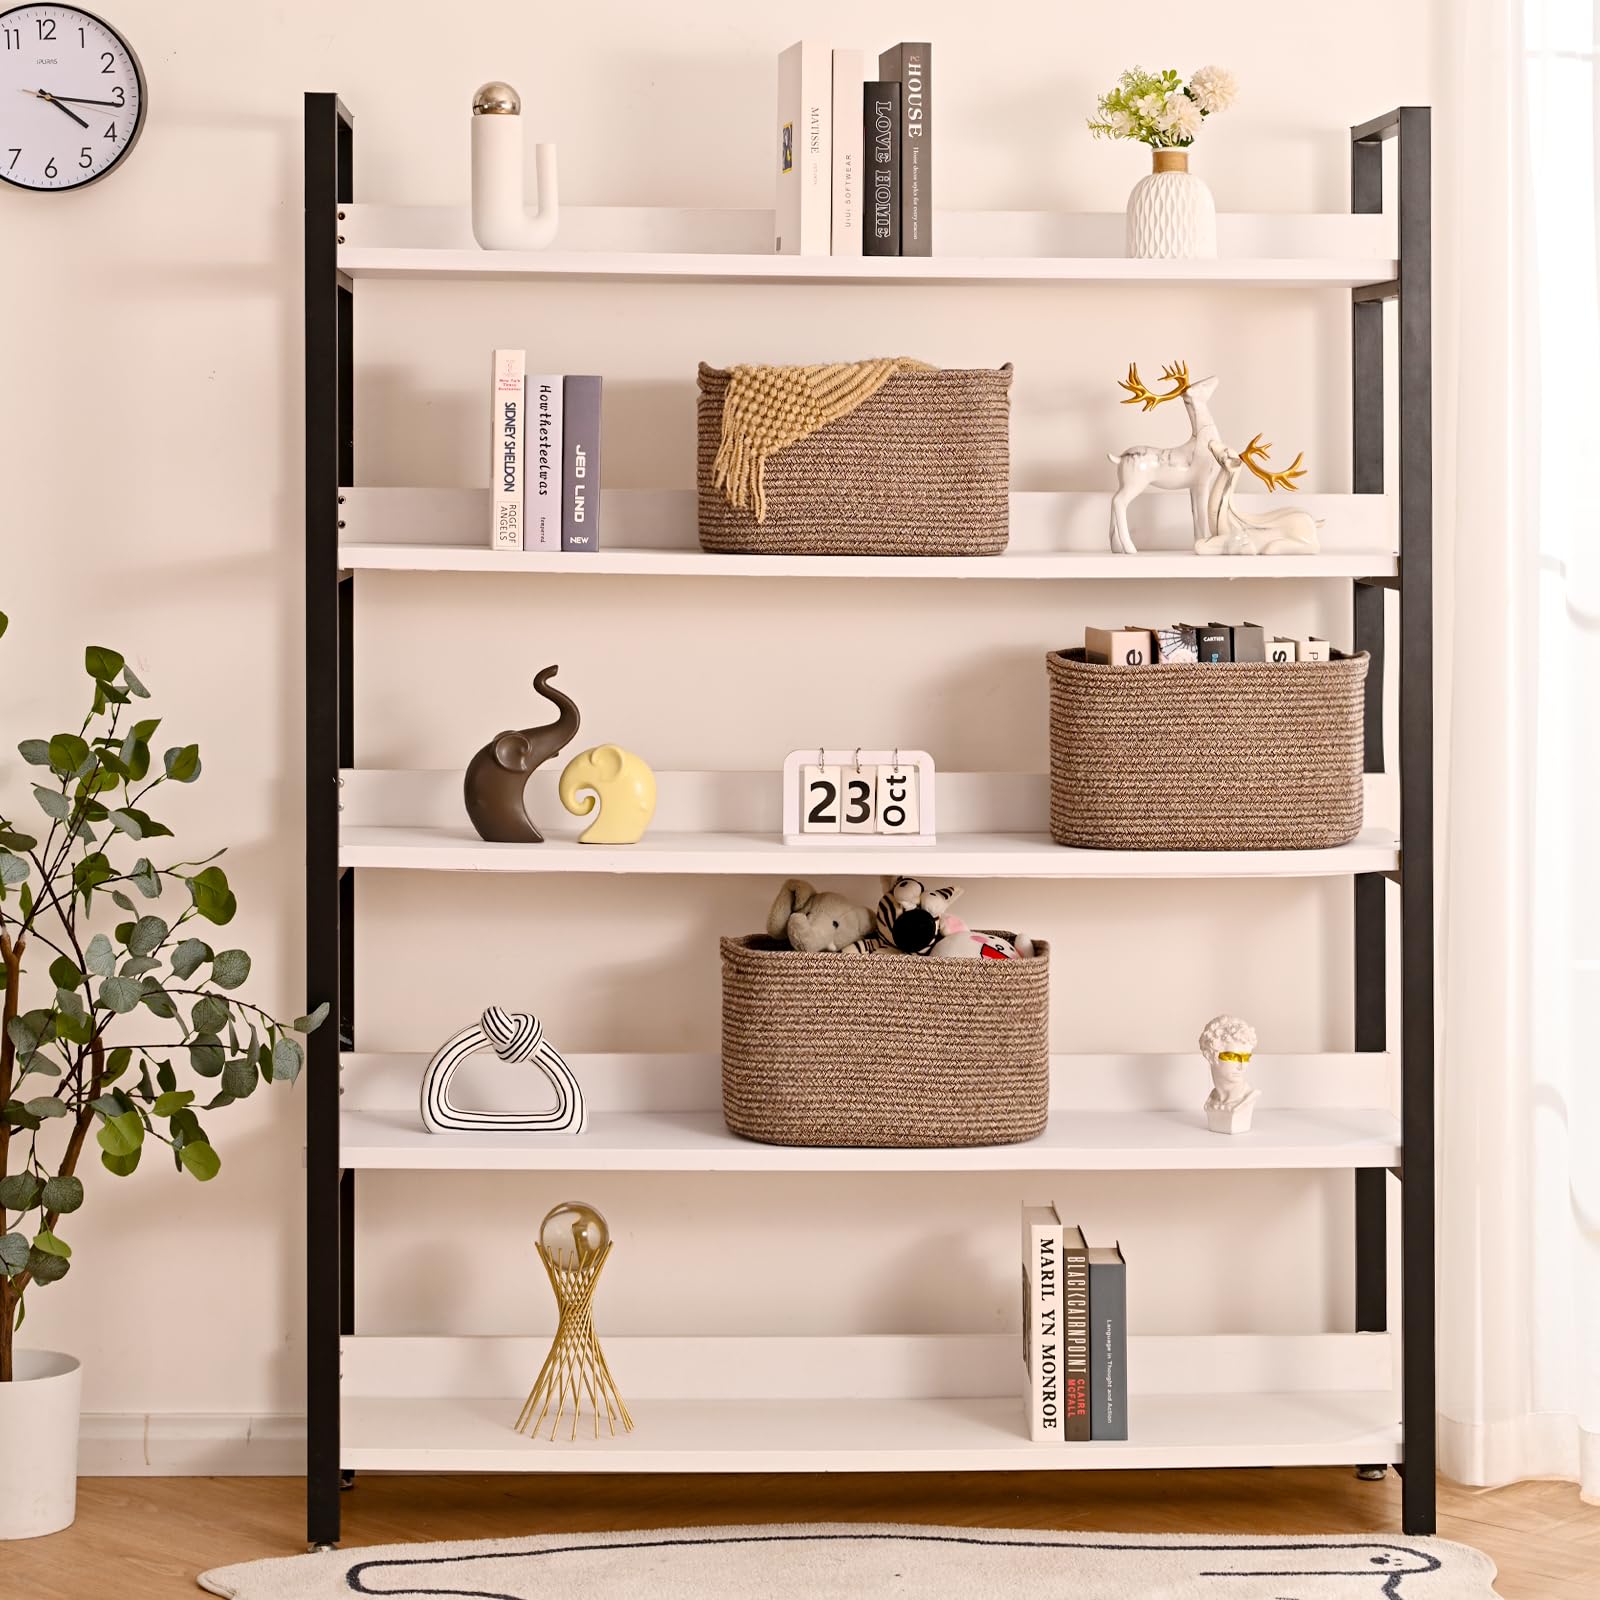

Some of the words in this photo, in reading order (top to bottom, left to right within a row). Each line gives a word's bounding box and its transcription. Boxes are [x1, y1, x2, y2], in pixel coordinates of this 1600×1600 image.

[4, 29, 20, 50] 11
[36, 19, 56, 40] 12
[78, 27, 85, 48] 1
[100, 52, 115, 73] 2
[111, 86, 125, 108] 3
[908, 63, 923, 138] HOUSE
[103, 121, 118, 142] 4
[810, 107, 819, 154] MATISSE
[875, 101, 892, 163] LOVE
[8, 148, 22, 170] 7
[44, 157, 58, 178] 6
[78, 147, 93, 169] 5
[844, 154, 852, 204] SOFTWEAR
[875, 169, 892, 239] HOME
[504, 402, 516, 439] SIDNEY
[539, 385, 552, 496] Howthesteelwas
[504, 441, 516, 492] SHELDON
[575, 444, 586, 478] JED
[574, 484, 585, 523] LIND
[499, 506, 508, 541] ANGELS
[508, 532, 517, 544] OF
[570, 536, 589, 544] NEW
[1040, 1238, 1055, 1301] MARIL
[1041, 1309, 1056, 1336] YN
[1042, 1344, 1057, 1429] MONROE
[1067, 1379, 1076, 1417] MCFALL
[1077, 1379, 1086, 1415] CLAIRE
